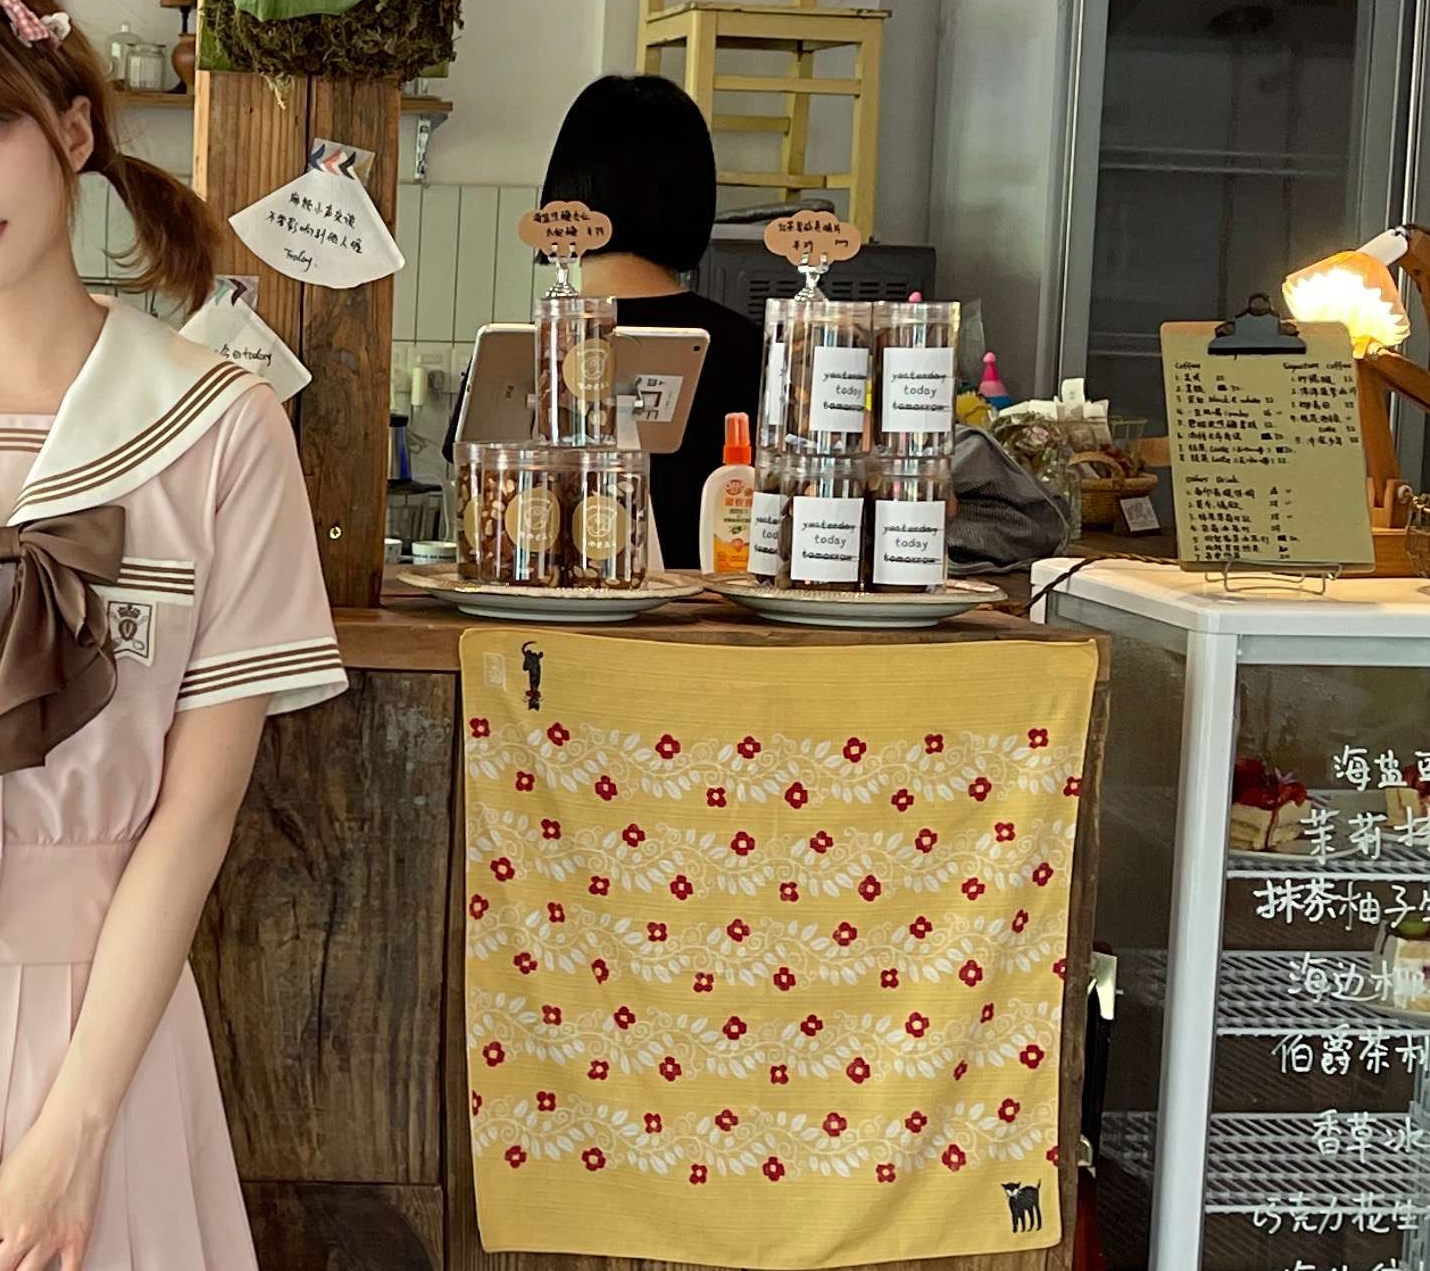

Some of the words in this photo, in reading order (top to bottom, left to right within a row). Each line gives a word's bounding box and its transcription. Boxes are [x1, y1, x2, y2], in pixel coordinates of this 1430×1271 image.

[904, 385, 937, 398] today
[762, 529, 778, 540] tod
[814, 533, 847, 549] today
[896, 538, 929, 552] today
[1253, 877, 1430, 931] 抹茶柚子
[1252, 1191, 1430, 1234] 巧克力花生
